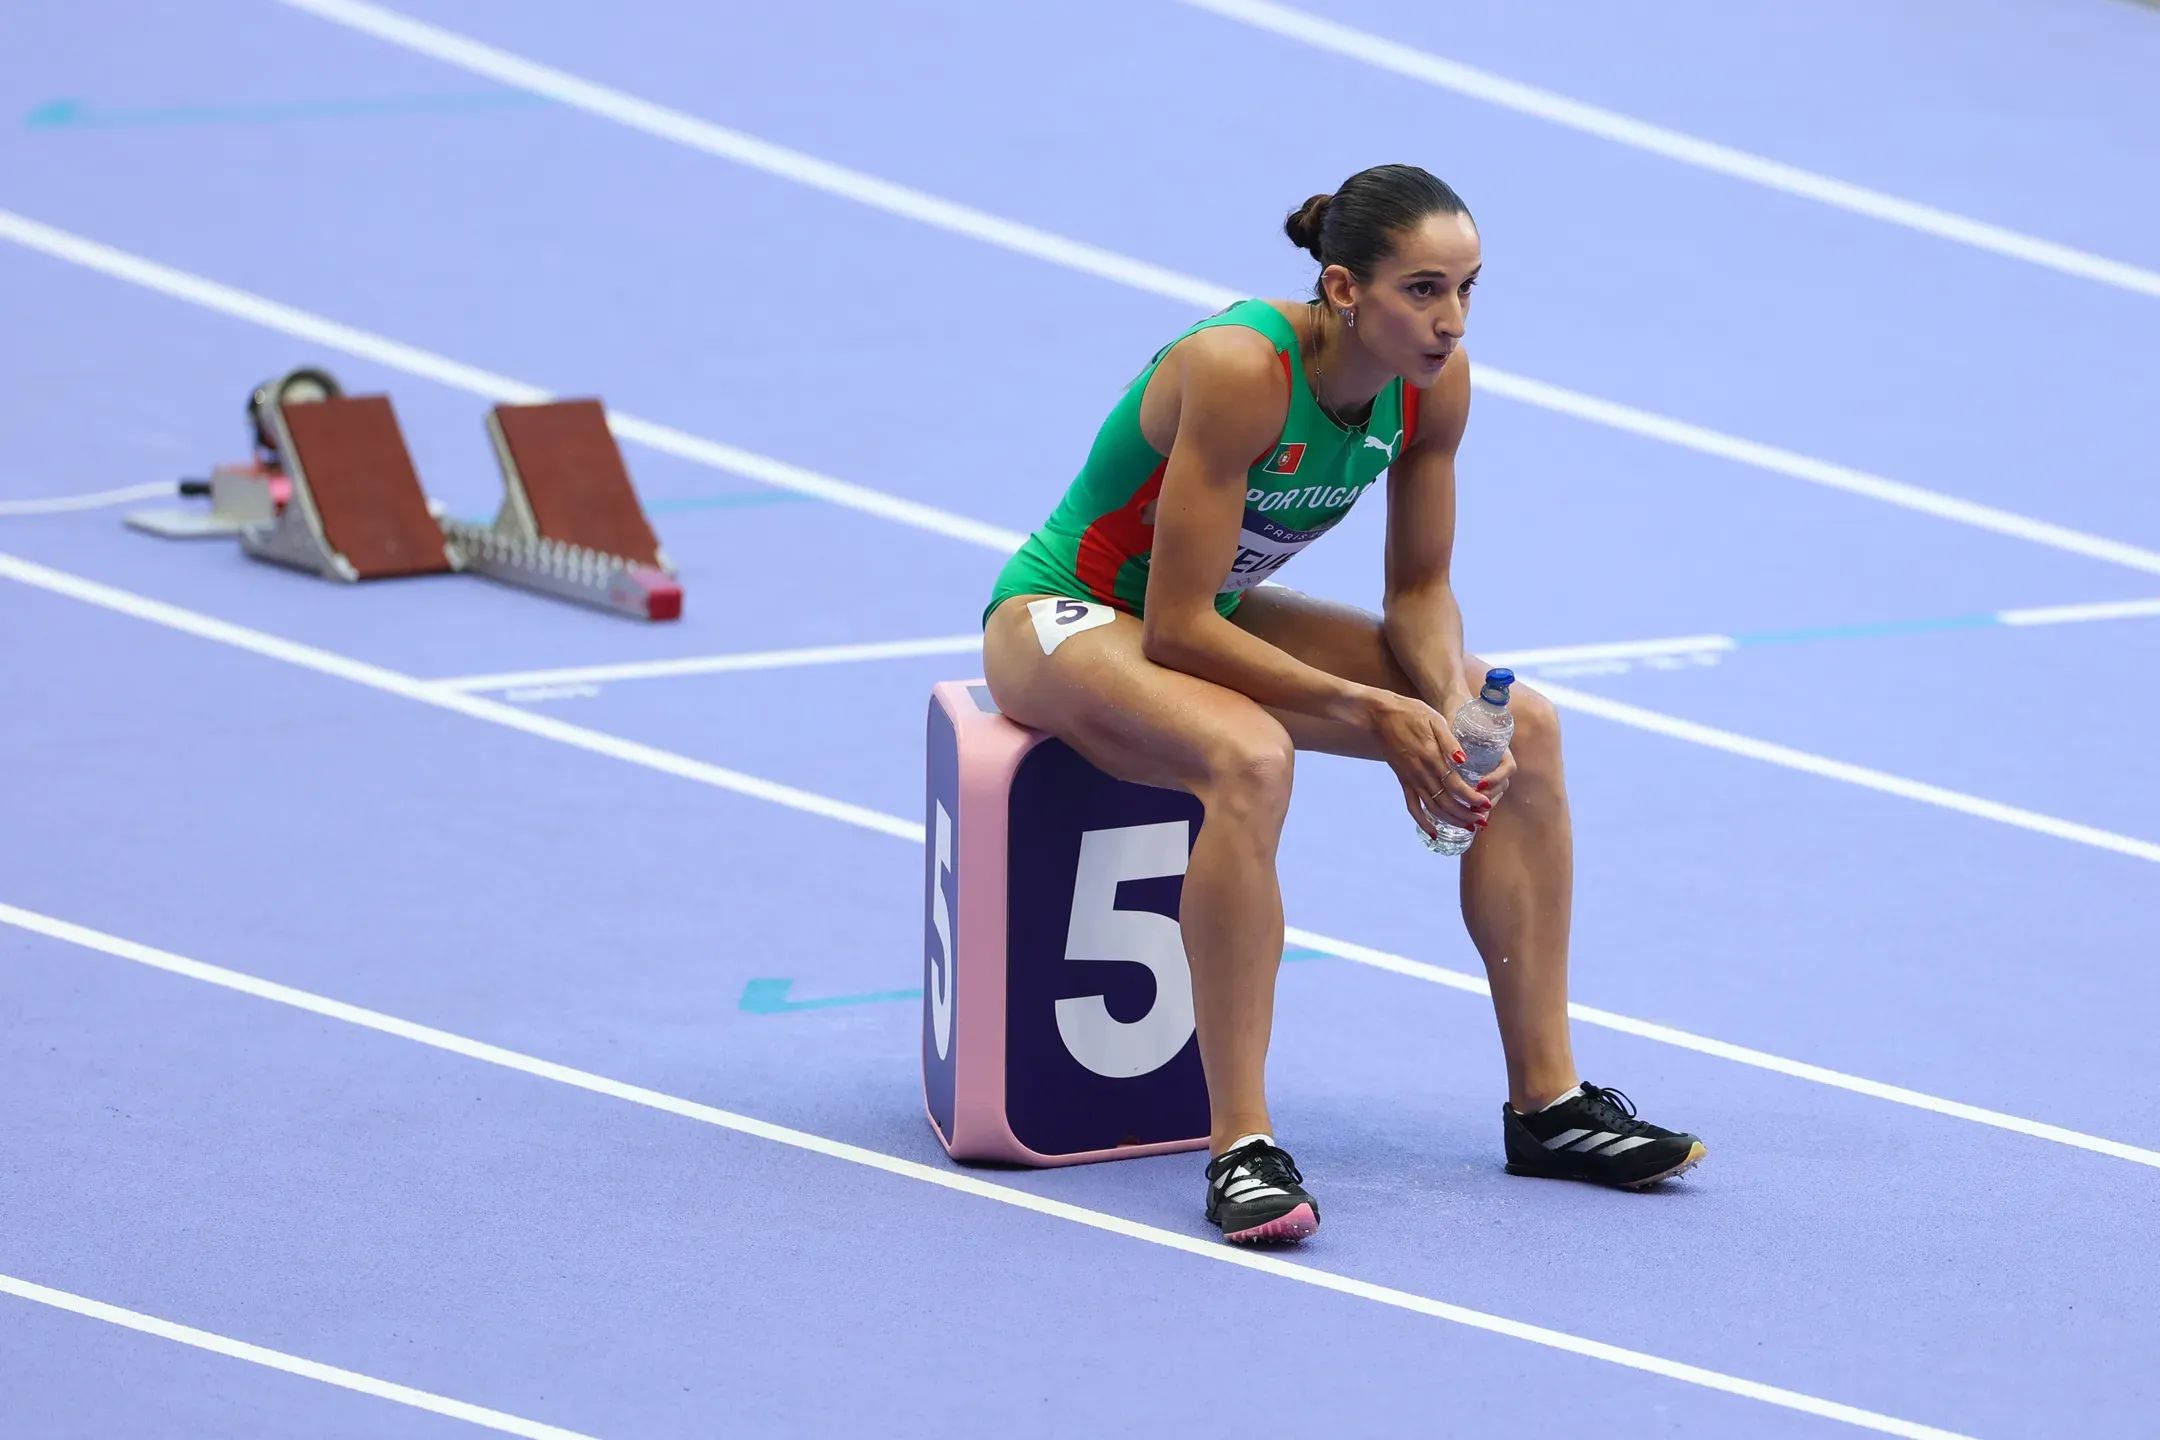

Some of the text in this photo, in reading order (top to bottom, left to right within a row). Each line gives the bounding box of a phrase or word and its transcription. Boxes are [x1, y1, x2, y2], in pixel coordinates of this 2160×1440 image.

[1246, 486, 1359, 511] PORTUGA
[1263, 523, 1308, 540] PARIS
[1055, 600, 1089, 625] 5
[931, 798, 952, 1061] 5
[1054, 819, 1196, 1079] 5
